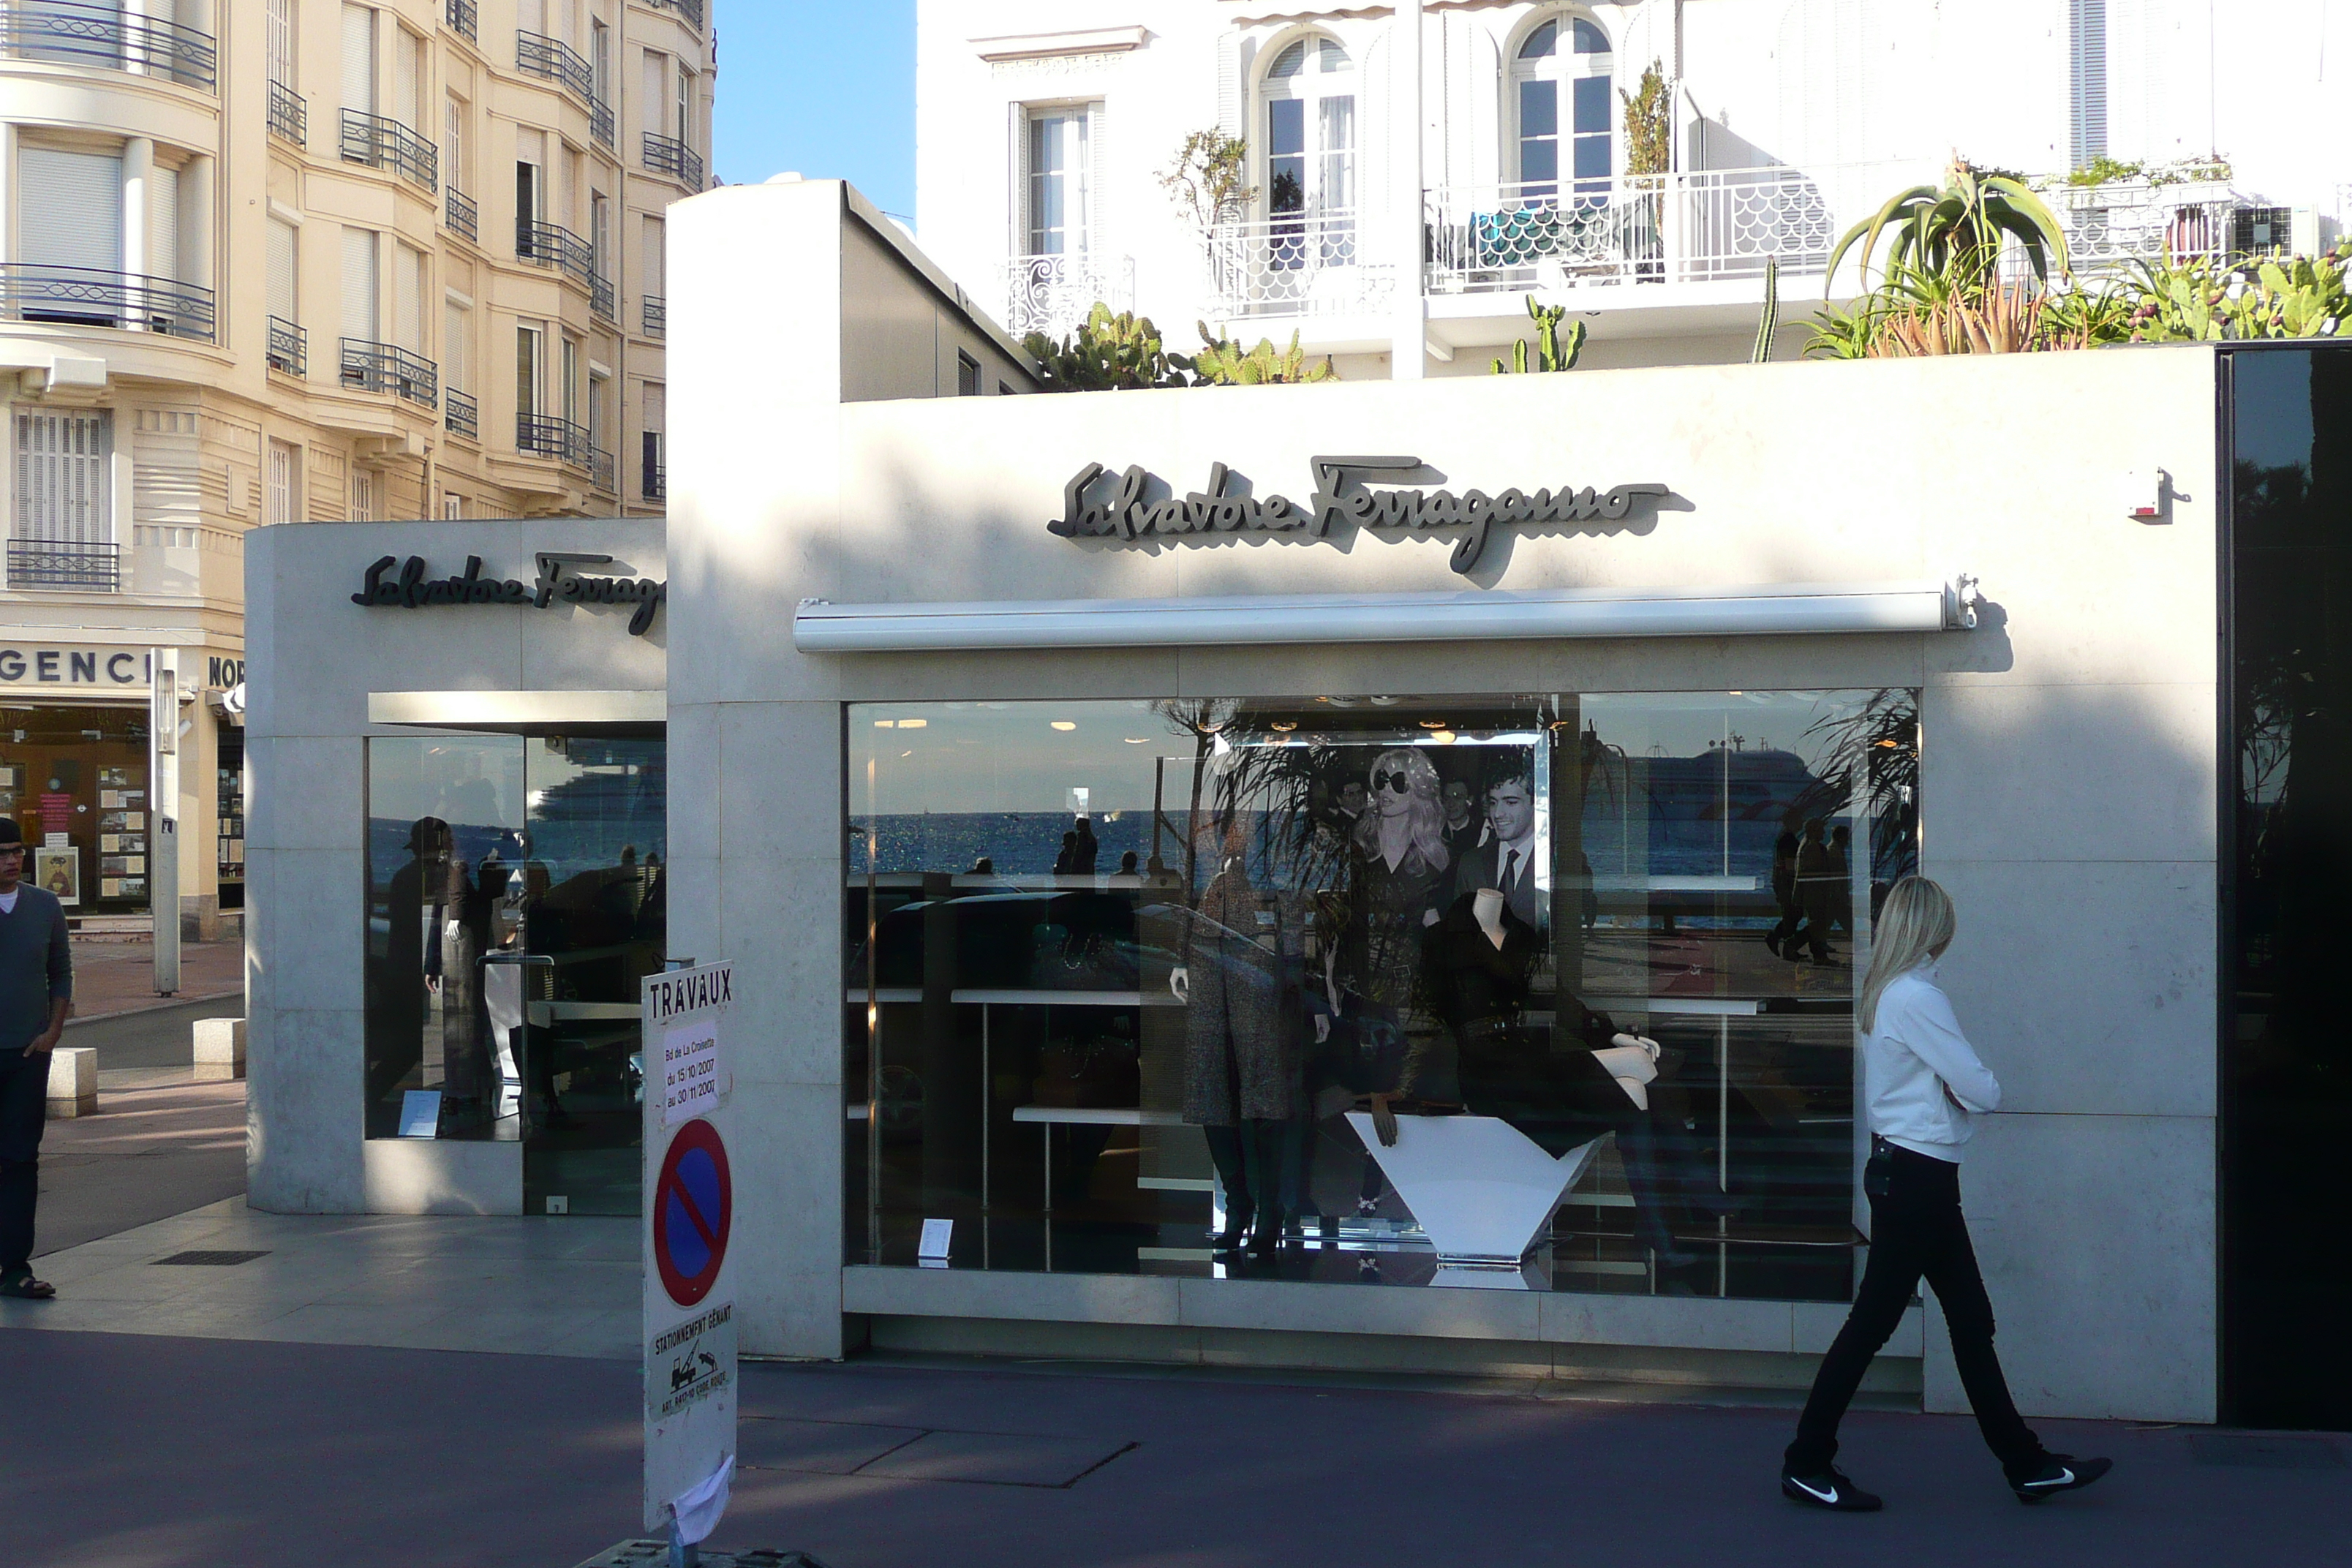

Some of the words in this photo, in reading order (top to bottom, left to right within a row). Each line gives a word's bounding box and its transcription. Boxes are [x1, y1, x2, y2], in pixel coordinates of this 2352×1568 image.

[1047, 461, 1306, 540] Salvatore
[1311, 456, 1670, 574] Ferragamo
[351, 555, 534, 608] Salvatore
[533, 552, 667, 636] Ferrag
[0, 649, 151, 684] GENC
[650, 968, 731, 1019] TRAVAUX
[666, 1048, 674, 1061] Bd
[675, 1046, 682, 1058] de
[683, 1044, 690, 1056] La
[691, 1037, 715, 1053] Croisette
[667, 1072, 675, 1086] du
[668, 1096, 676, 1107] au
[655, 1316, 706, 1355] STATIONNEMENT
[708, 1305, 731, 1330] GÊNANT
